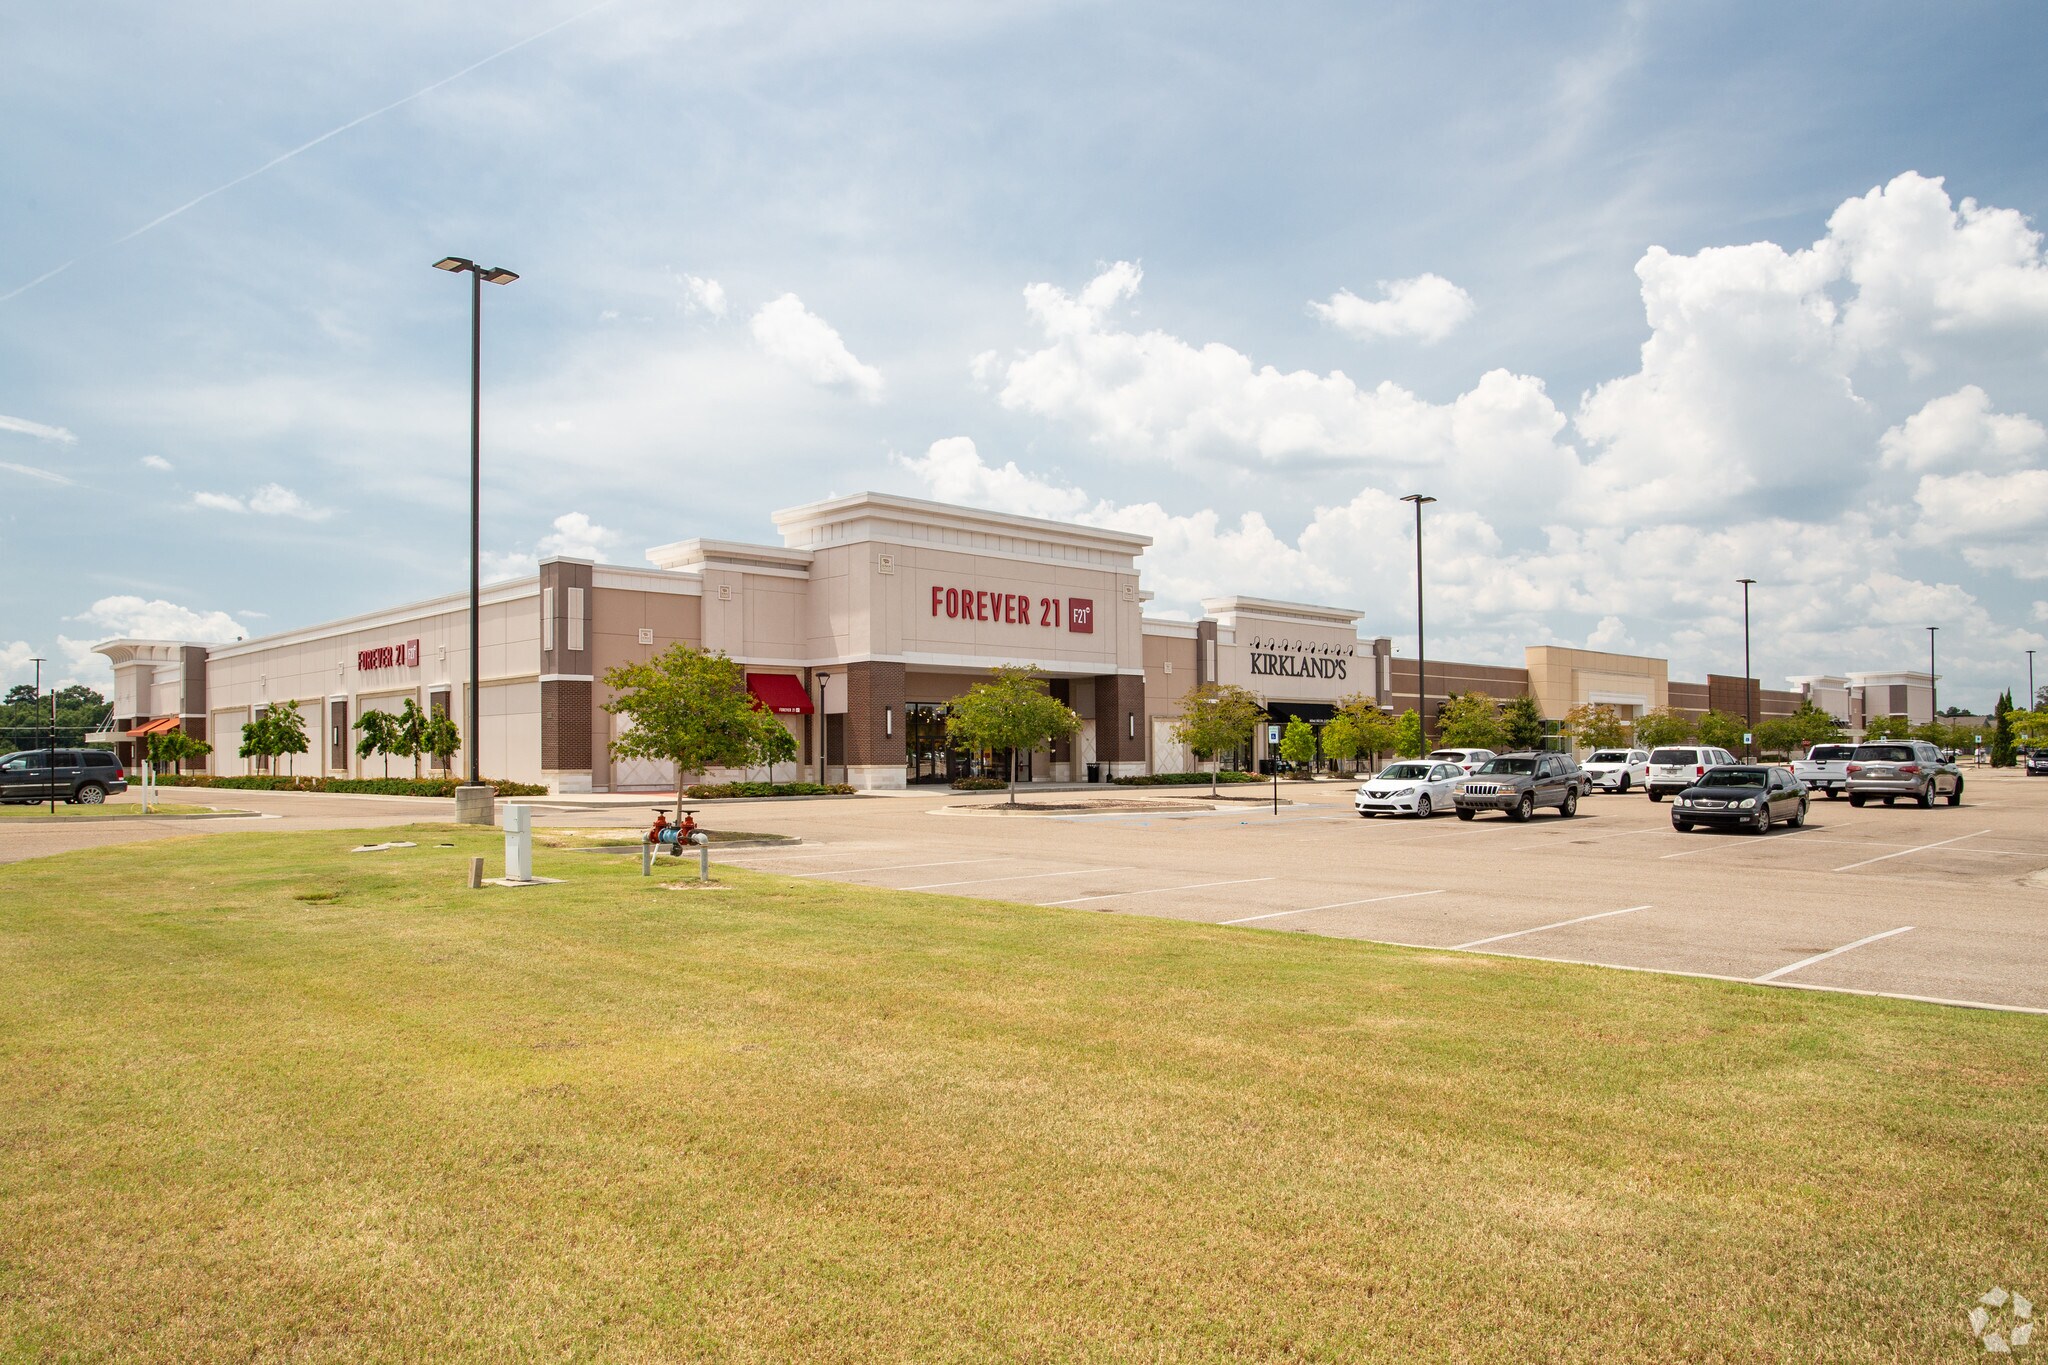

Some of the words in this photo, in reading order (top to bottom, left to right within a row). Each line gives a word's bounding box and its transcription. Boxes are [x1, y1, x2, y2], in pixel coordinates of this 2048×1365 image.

[932, 586, 1030, 625] FOREVER
[1040, 597, 1060, 627] 21
[358, 646, 393, 671] FOREVER
[396, 644, 405, 666] 21
[1250, 652, 1347, 680] KIRKLAND'S
